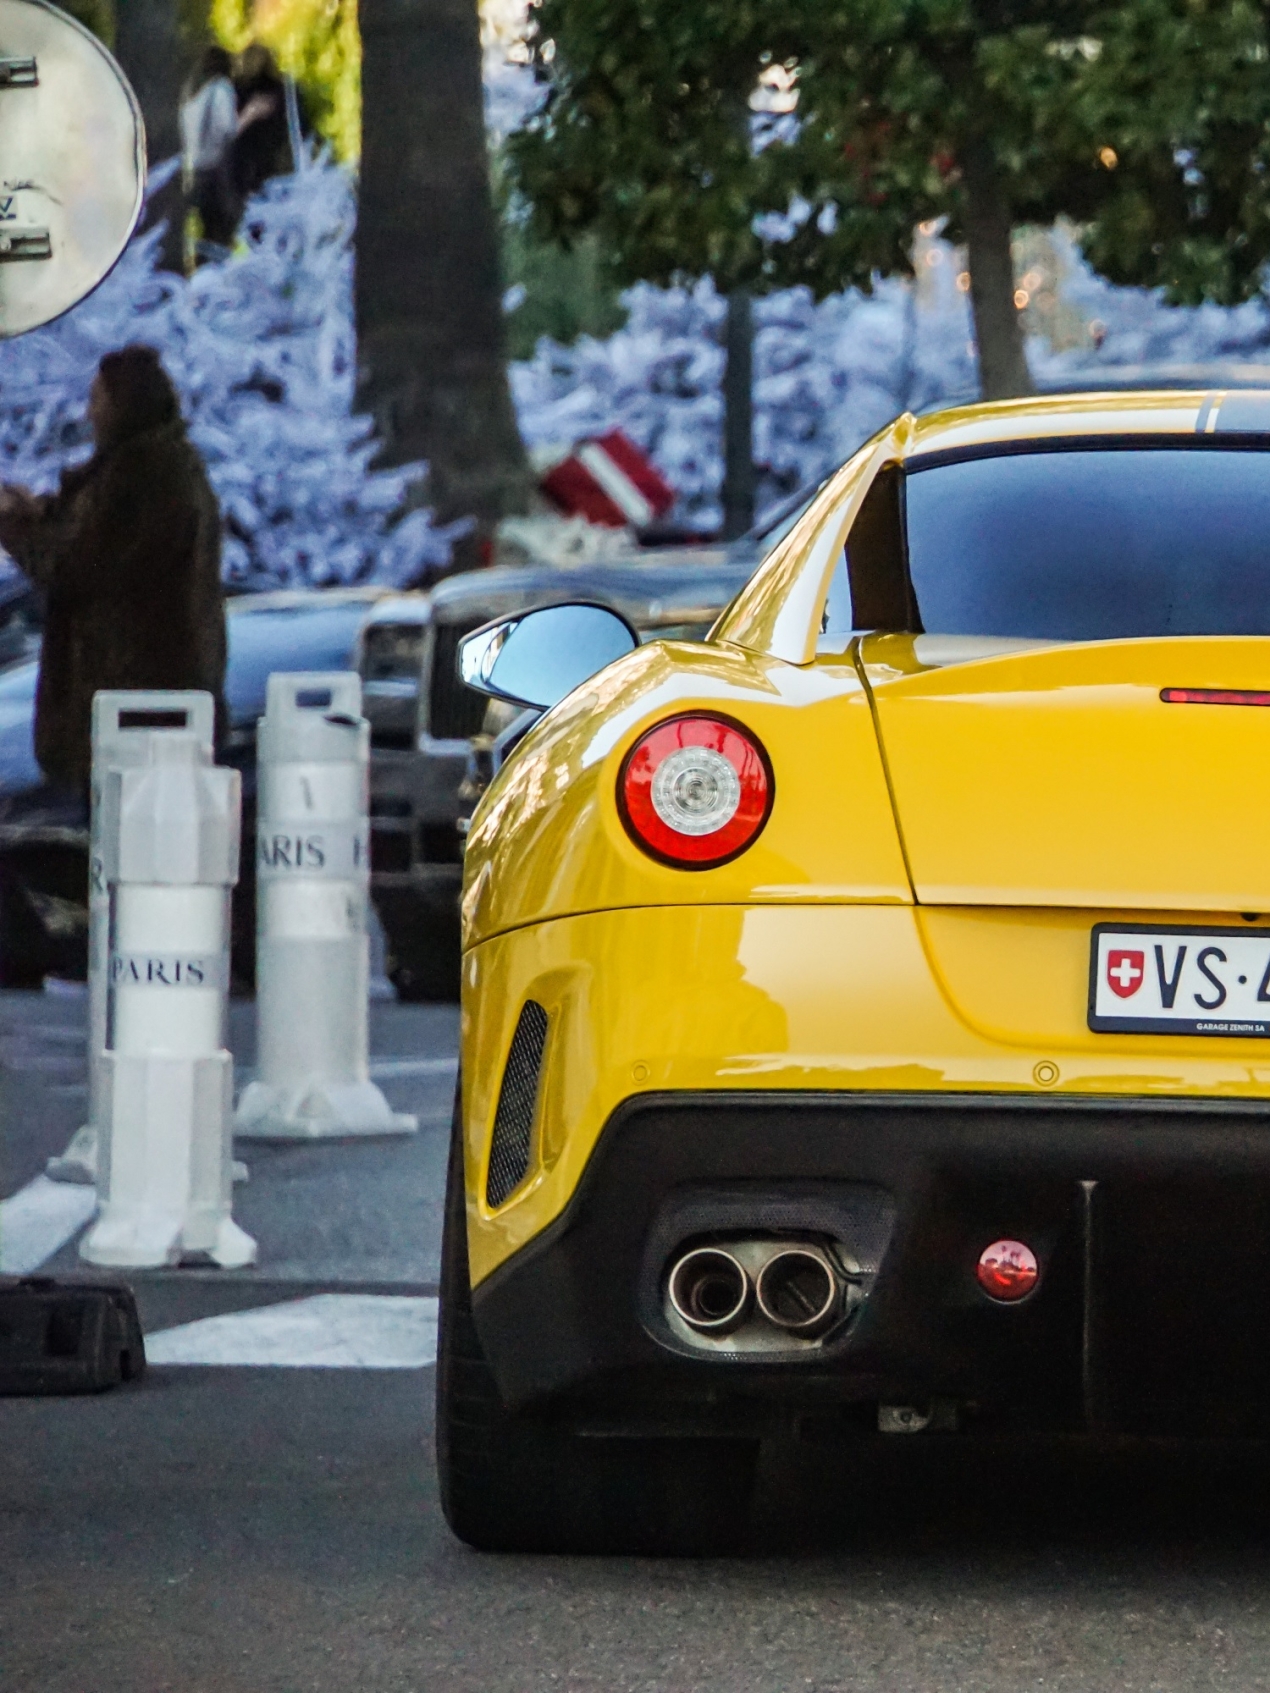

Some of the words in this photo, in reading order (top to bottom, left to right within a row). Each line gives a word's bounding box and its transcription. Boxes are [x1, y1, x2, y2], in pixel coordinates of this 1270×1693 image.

[112, 958, 204, 985] PARIS
[1196, 1022, 1228, 1031] GARAGE
[1229, 1023, 1253, 1032] ZENITH
[1254, 1024, 1265, 1032] SA
